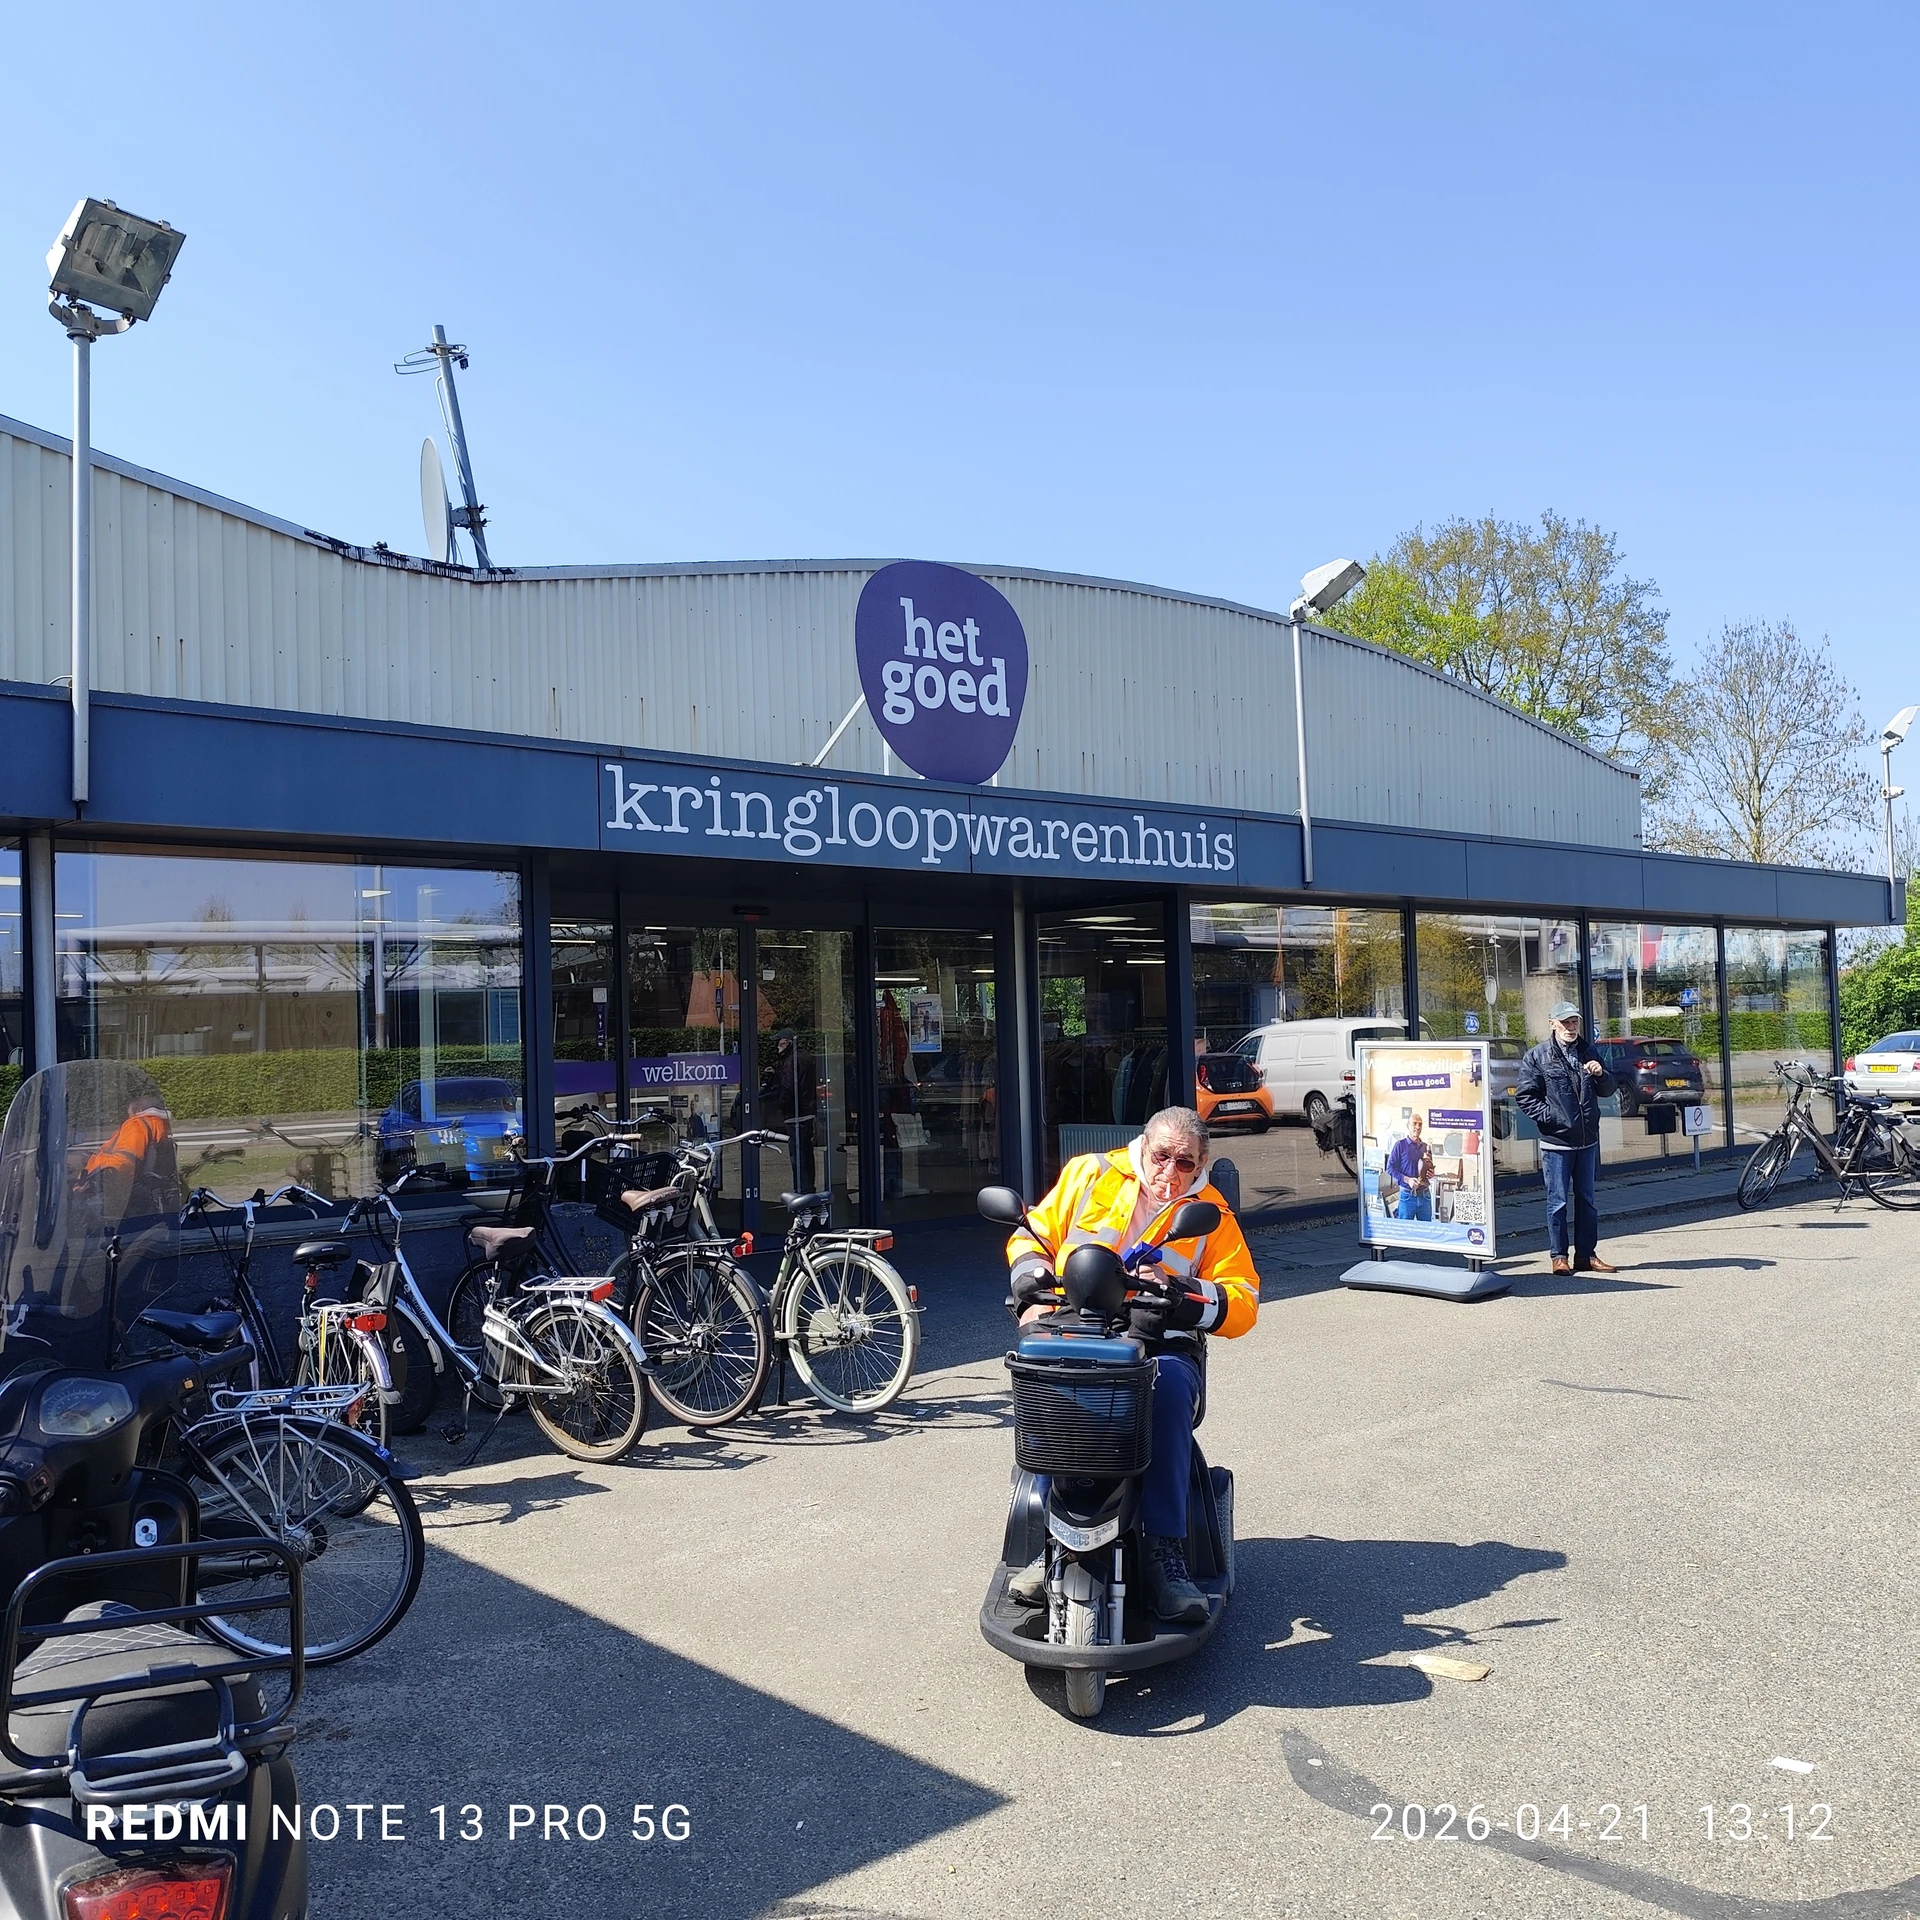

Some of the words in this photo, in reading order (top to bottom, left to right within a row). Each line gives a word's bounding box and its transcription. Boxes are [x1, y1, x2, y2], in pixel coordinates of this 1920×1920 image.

[900, 597, 982, 667] het
[882, 658, 1010, 725] goed
[605, 764, 1235, 872] kringloopwarenhuis
[642, 1061, 728, 1083] welkom
[1407, 1078, 1424, 1087] dan
[1425, 1077, 1445, 1088] goed
